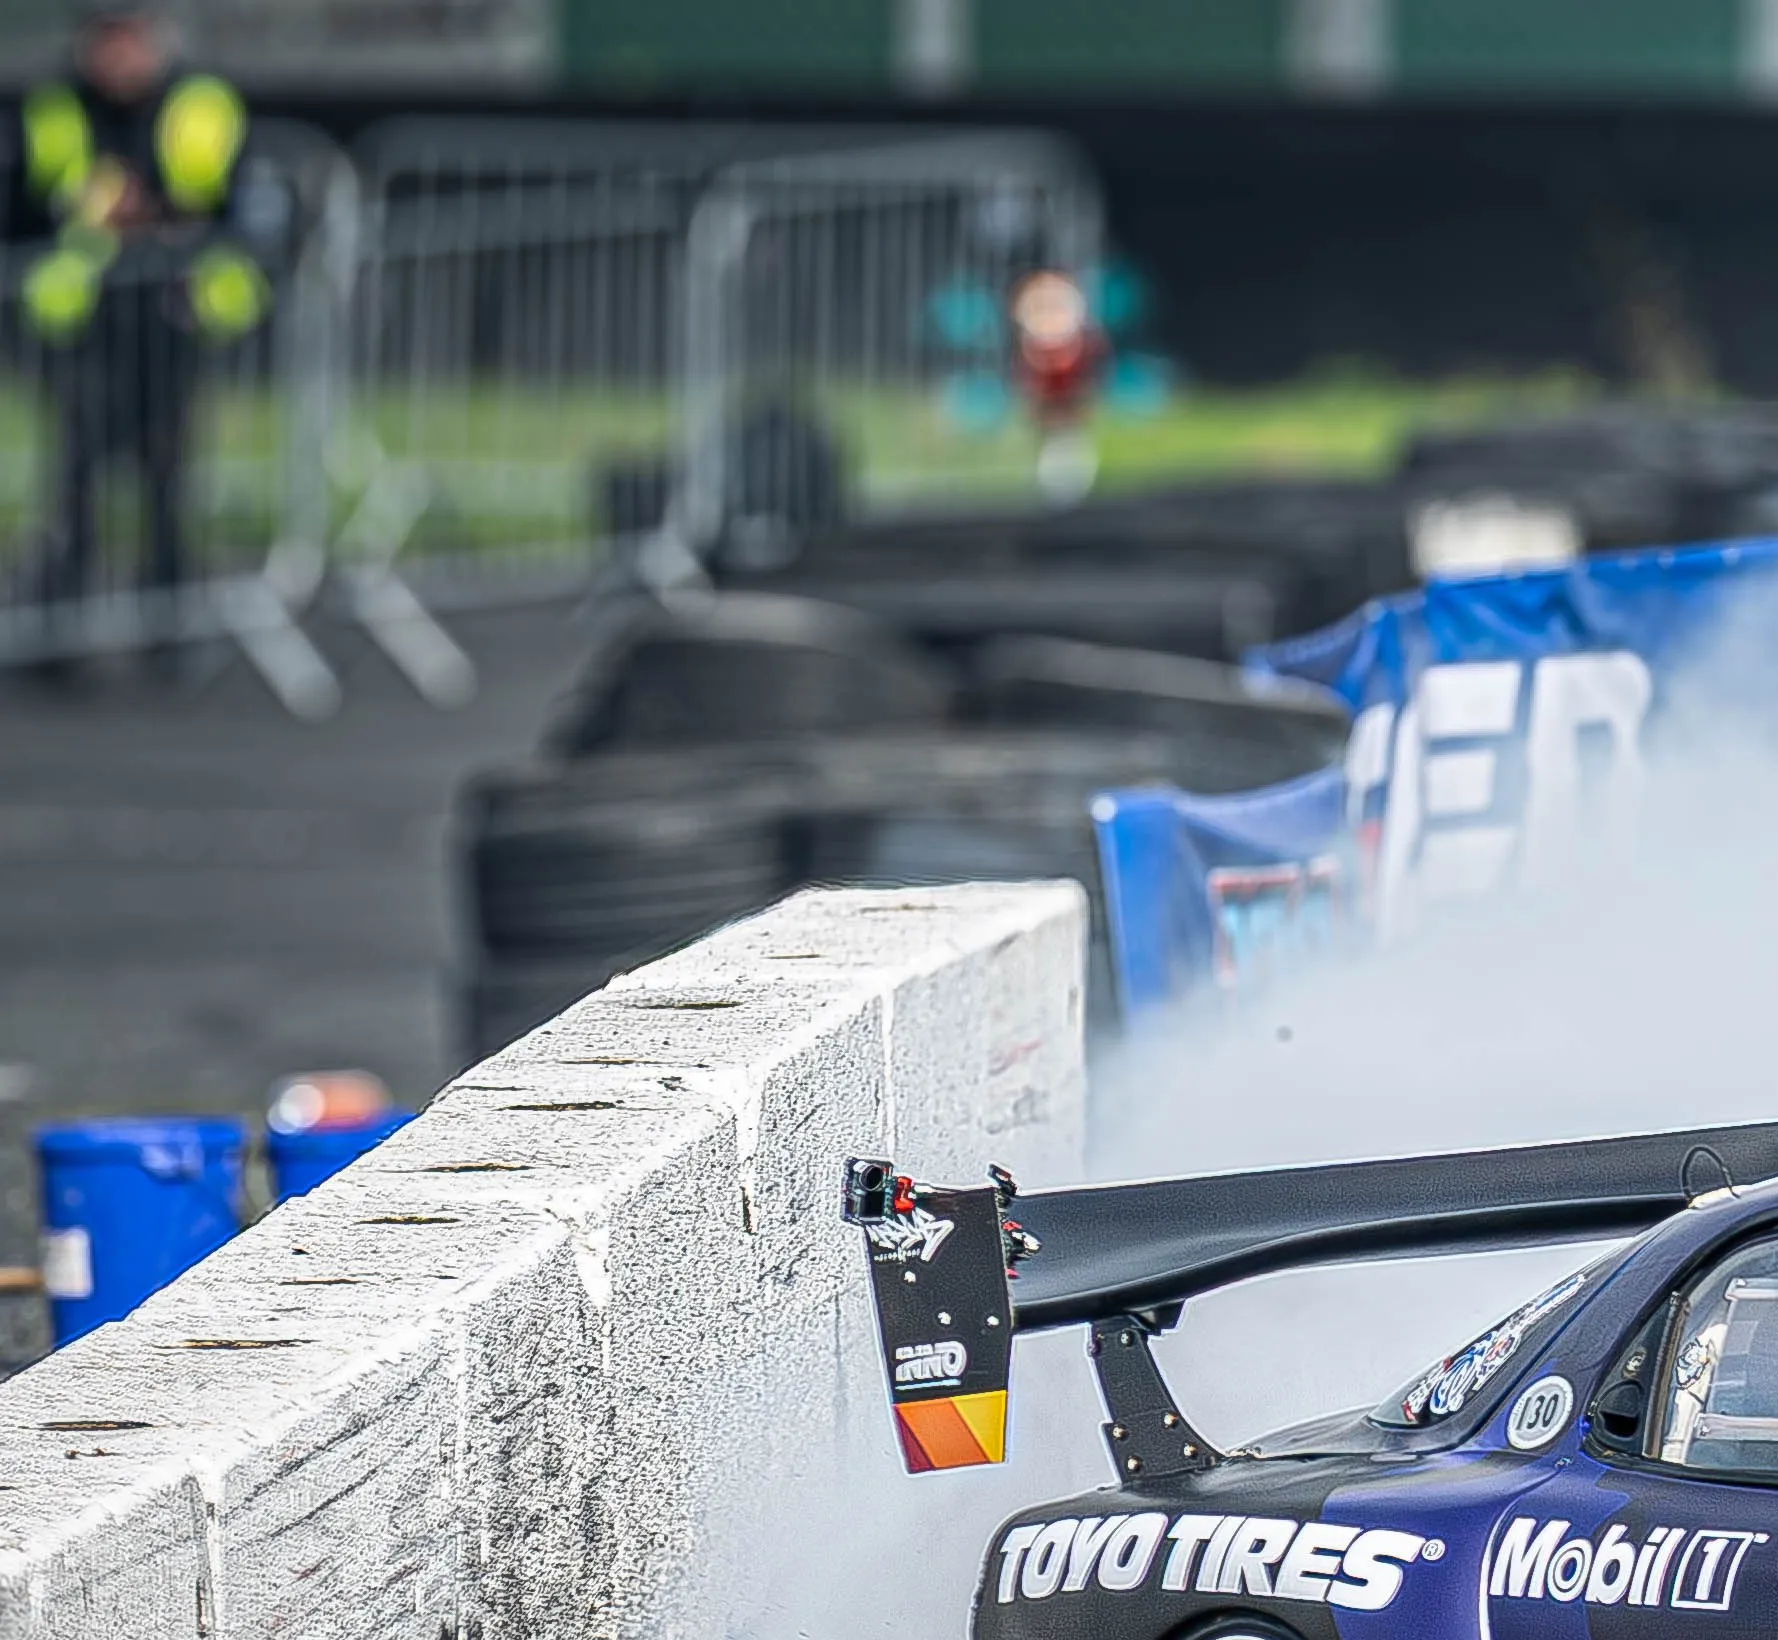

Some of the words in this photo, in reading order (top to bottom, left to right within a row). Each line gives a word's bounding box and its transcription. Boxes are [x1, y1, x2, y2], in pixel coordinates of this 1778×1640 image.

[1516, 1393, 1559, 1431] 130
[998, 1512, 1170, 1604] TOYO
[1489, 1517, 1684, 1606] Mobil
